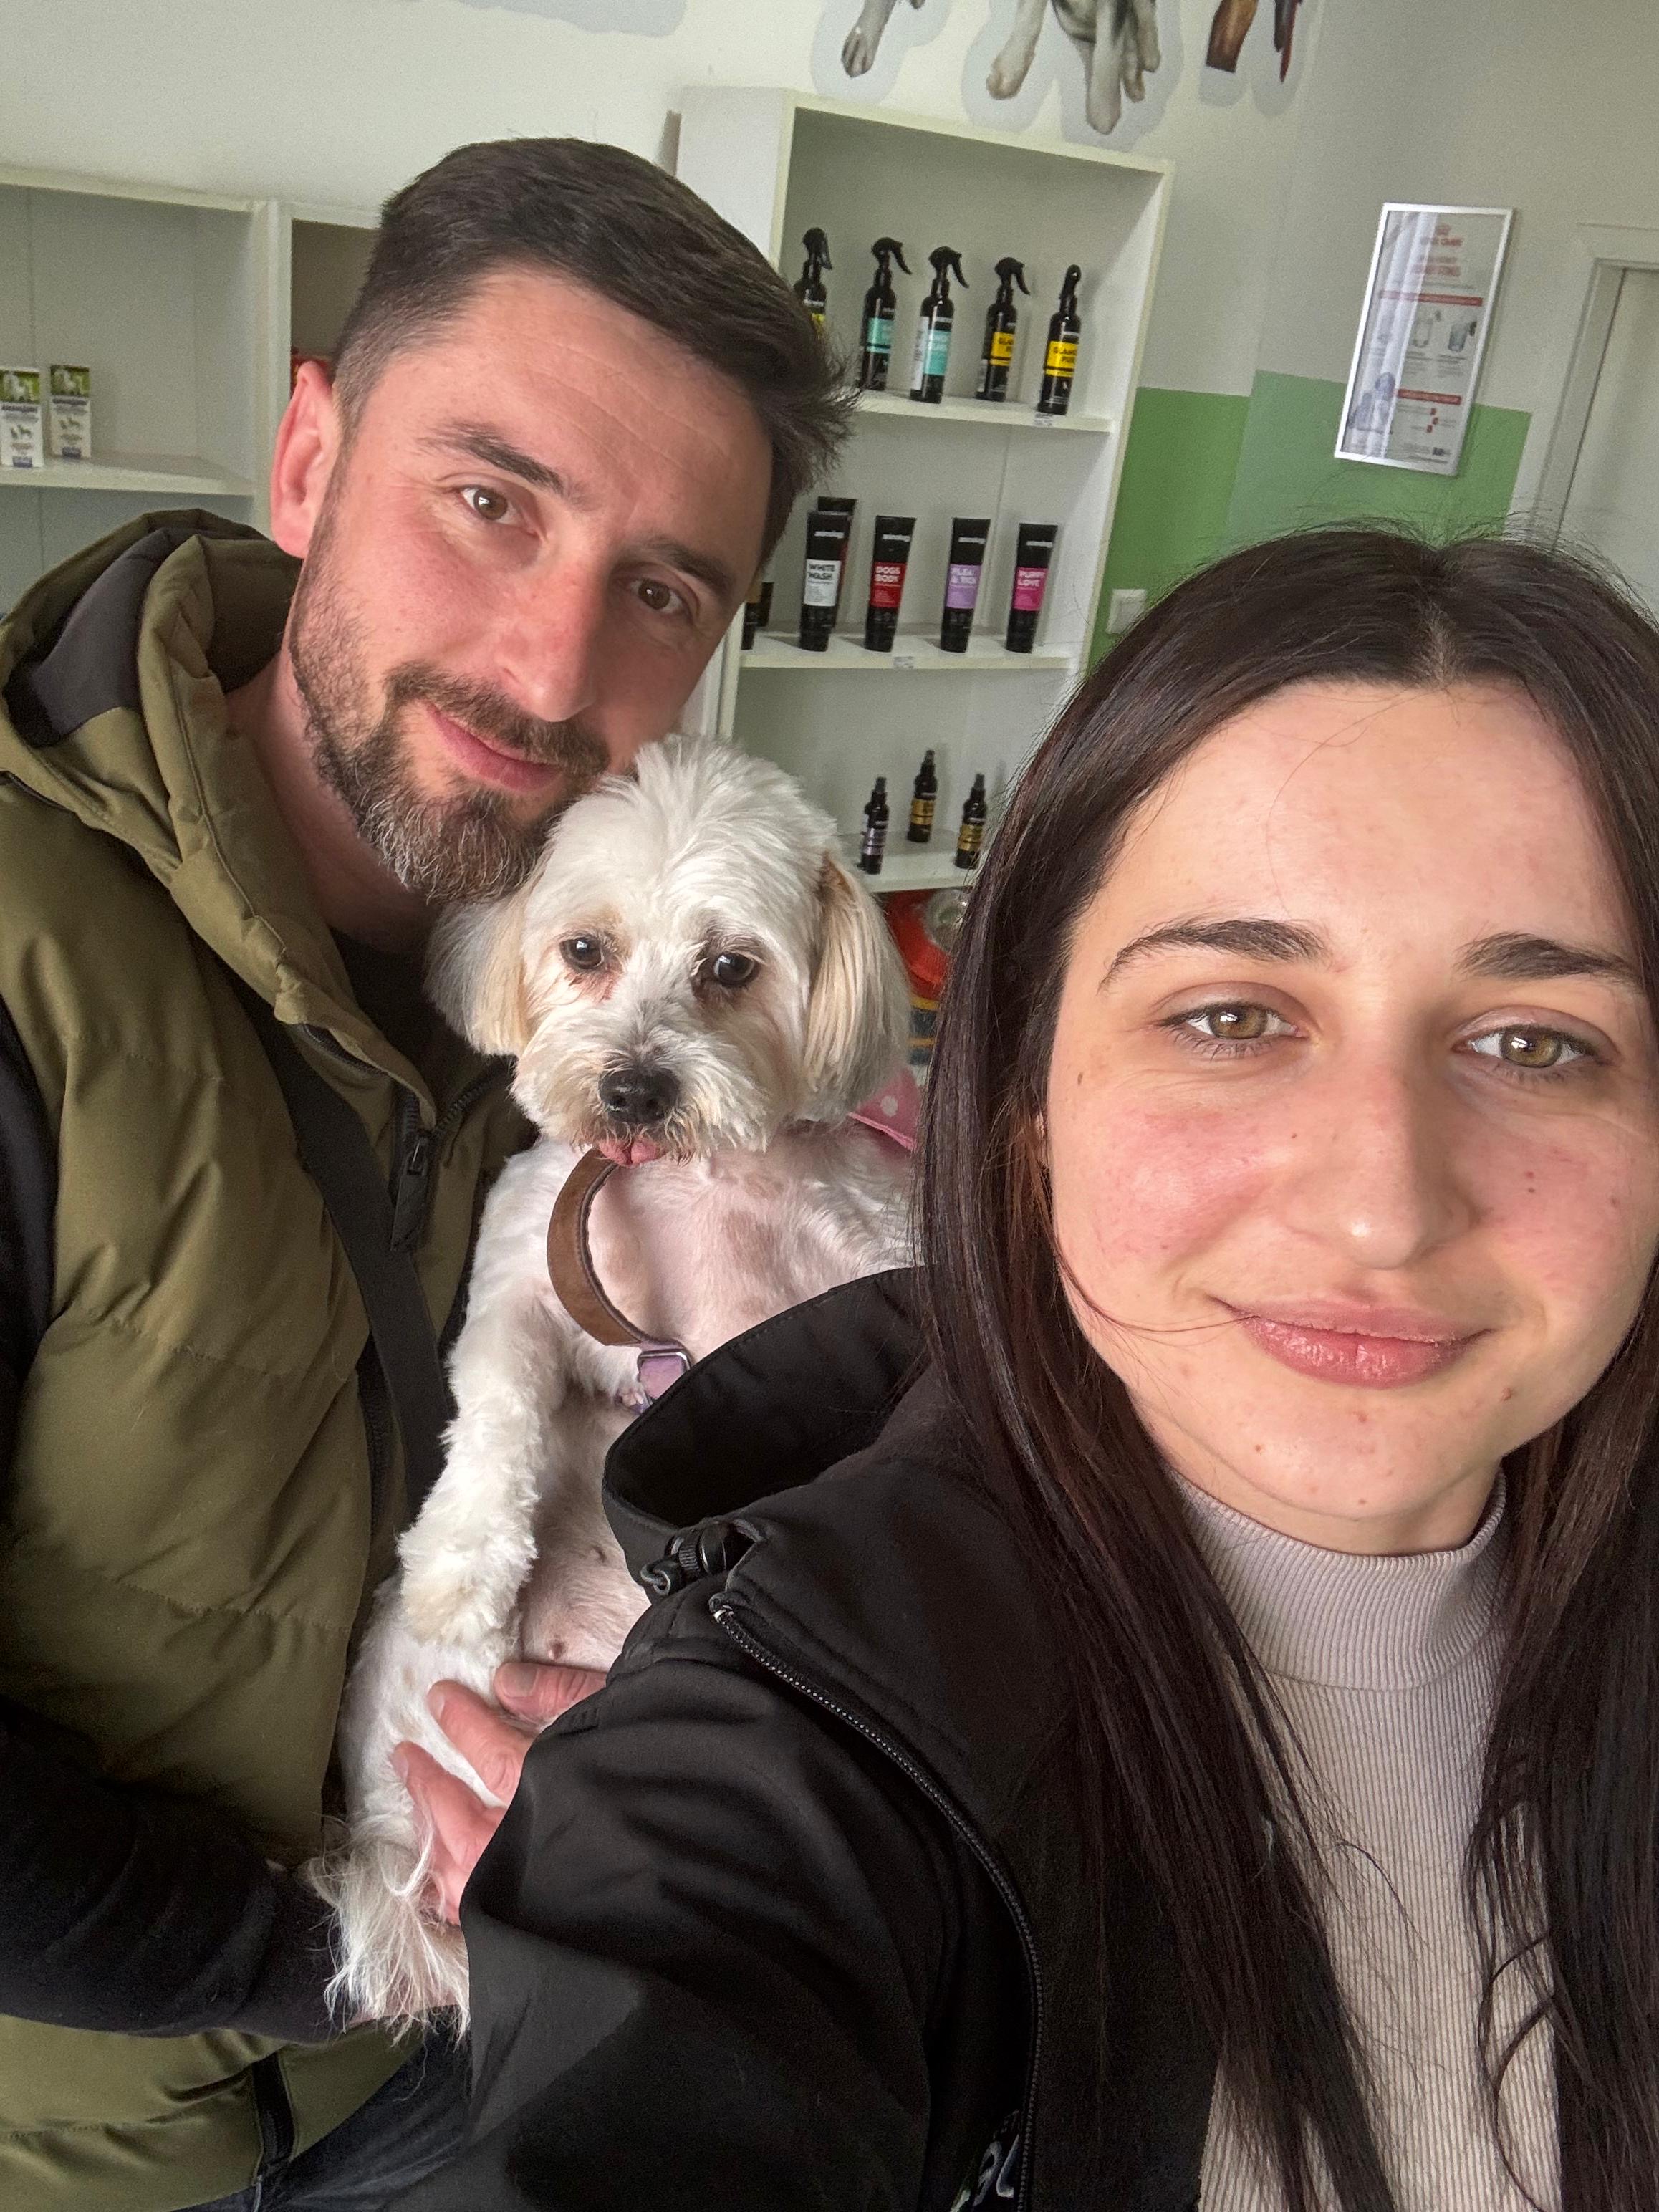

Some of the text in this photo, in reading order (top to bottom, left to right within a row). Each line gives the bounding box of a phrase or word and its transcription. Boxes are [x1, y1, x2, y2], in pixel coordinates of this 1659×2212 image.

[808, 564, 835, 572] WHITE
[875, 566, 901, 575] DOGS
[874, 574, 900, 583] BODY
